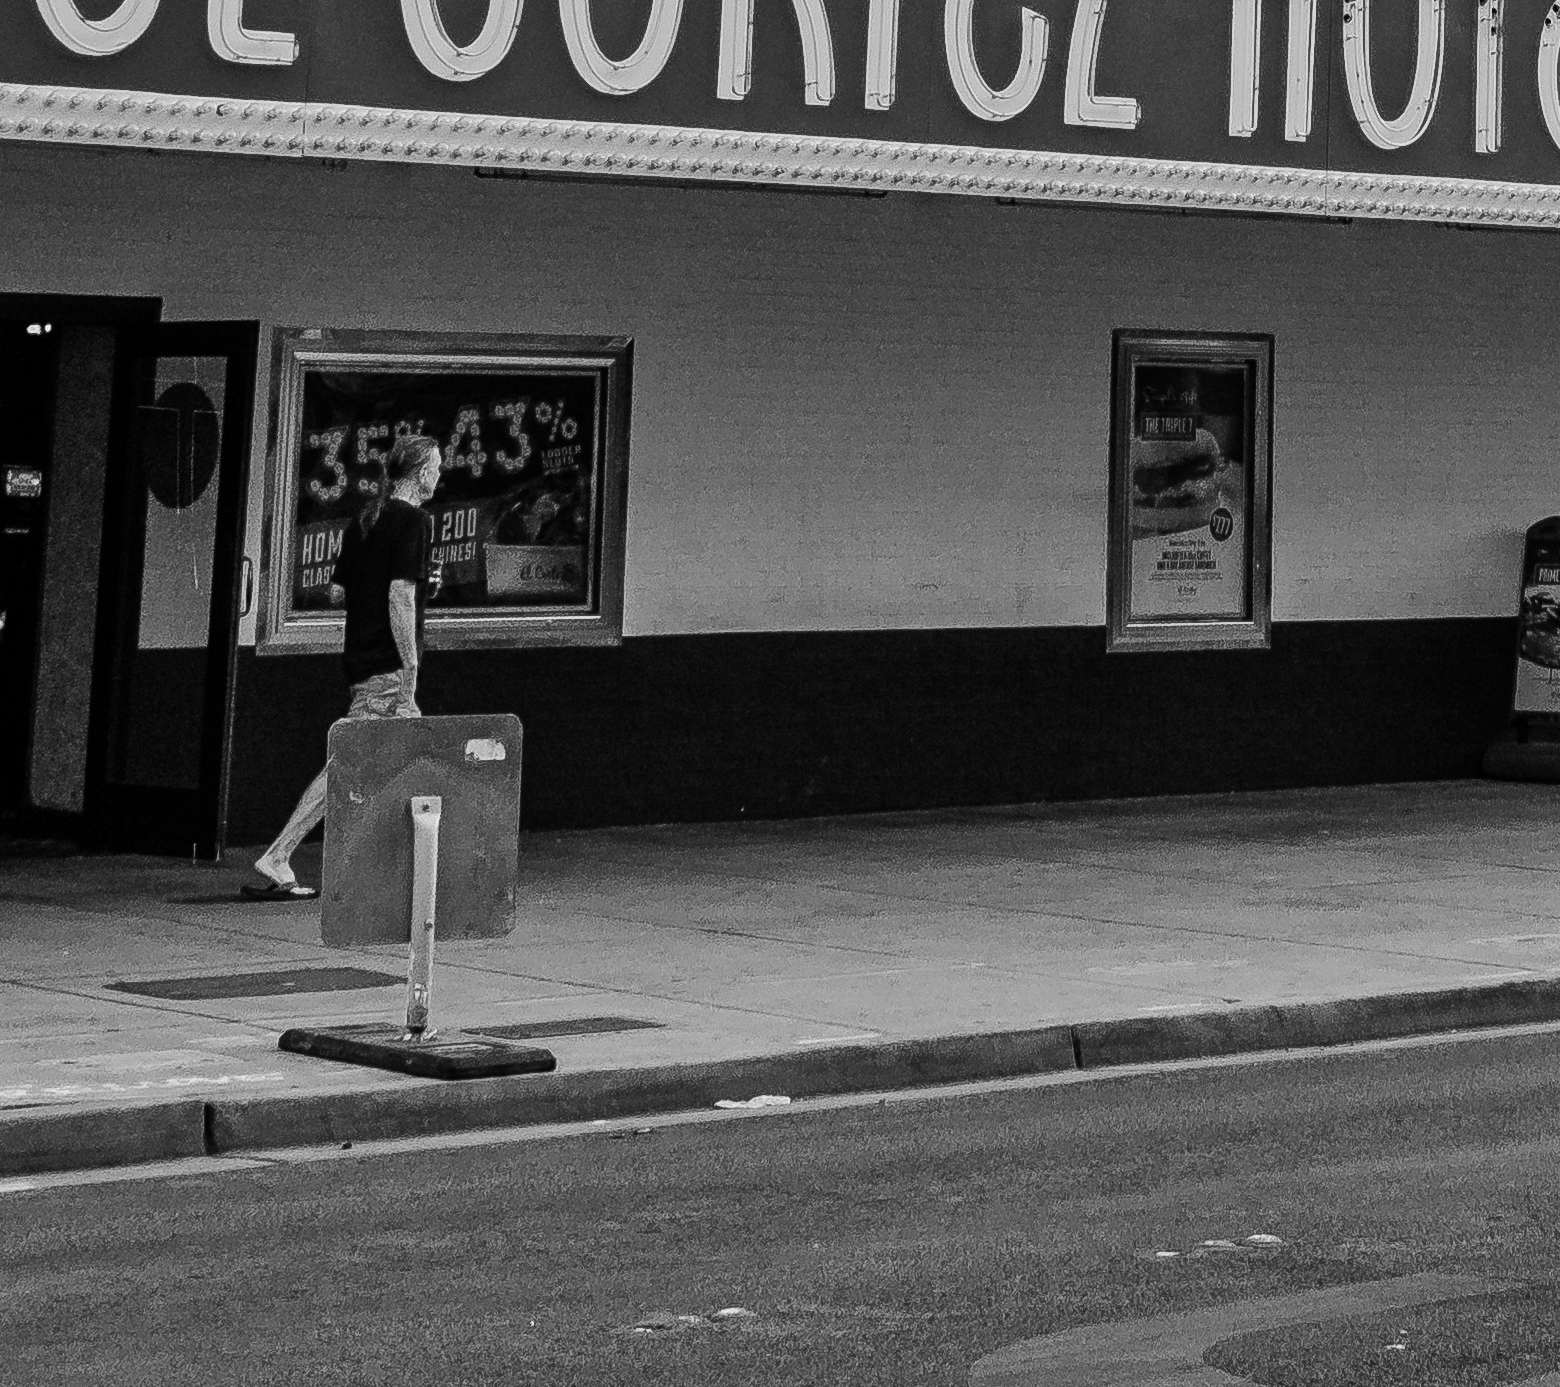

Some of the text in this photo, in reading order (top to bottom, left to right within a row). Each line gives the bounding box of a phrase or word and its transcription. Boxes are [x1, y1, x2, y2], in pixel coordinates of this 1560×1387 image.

[443, 399, 578, 477] 43%
[1145, 417, 1159, 434] THE
[302, 529, 344, 565] HOM
